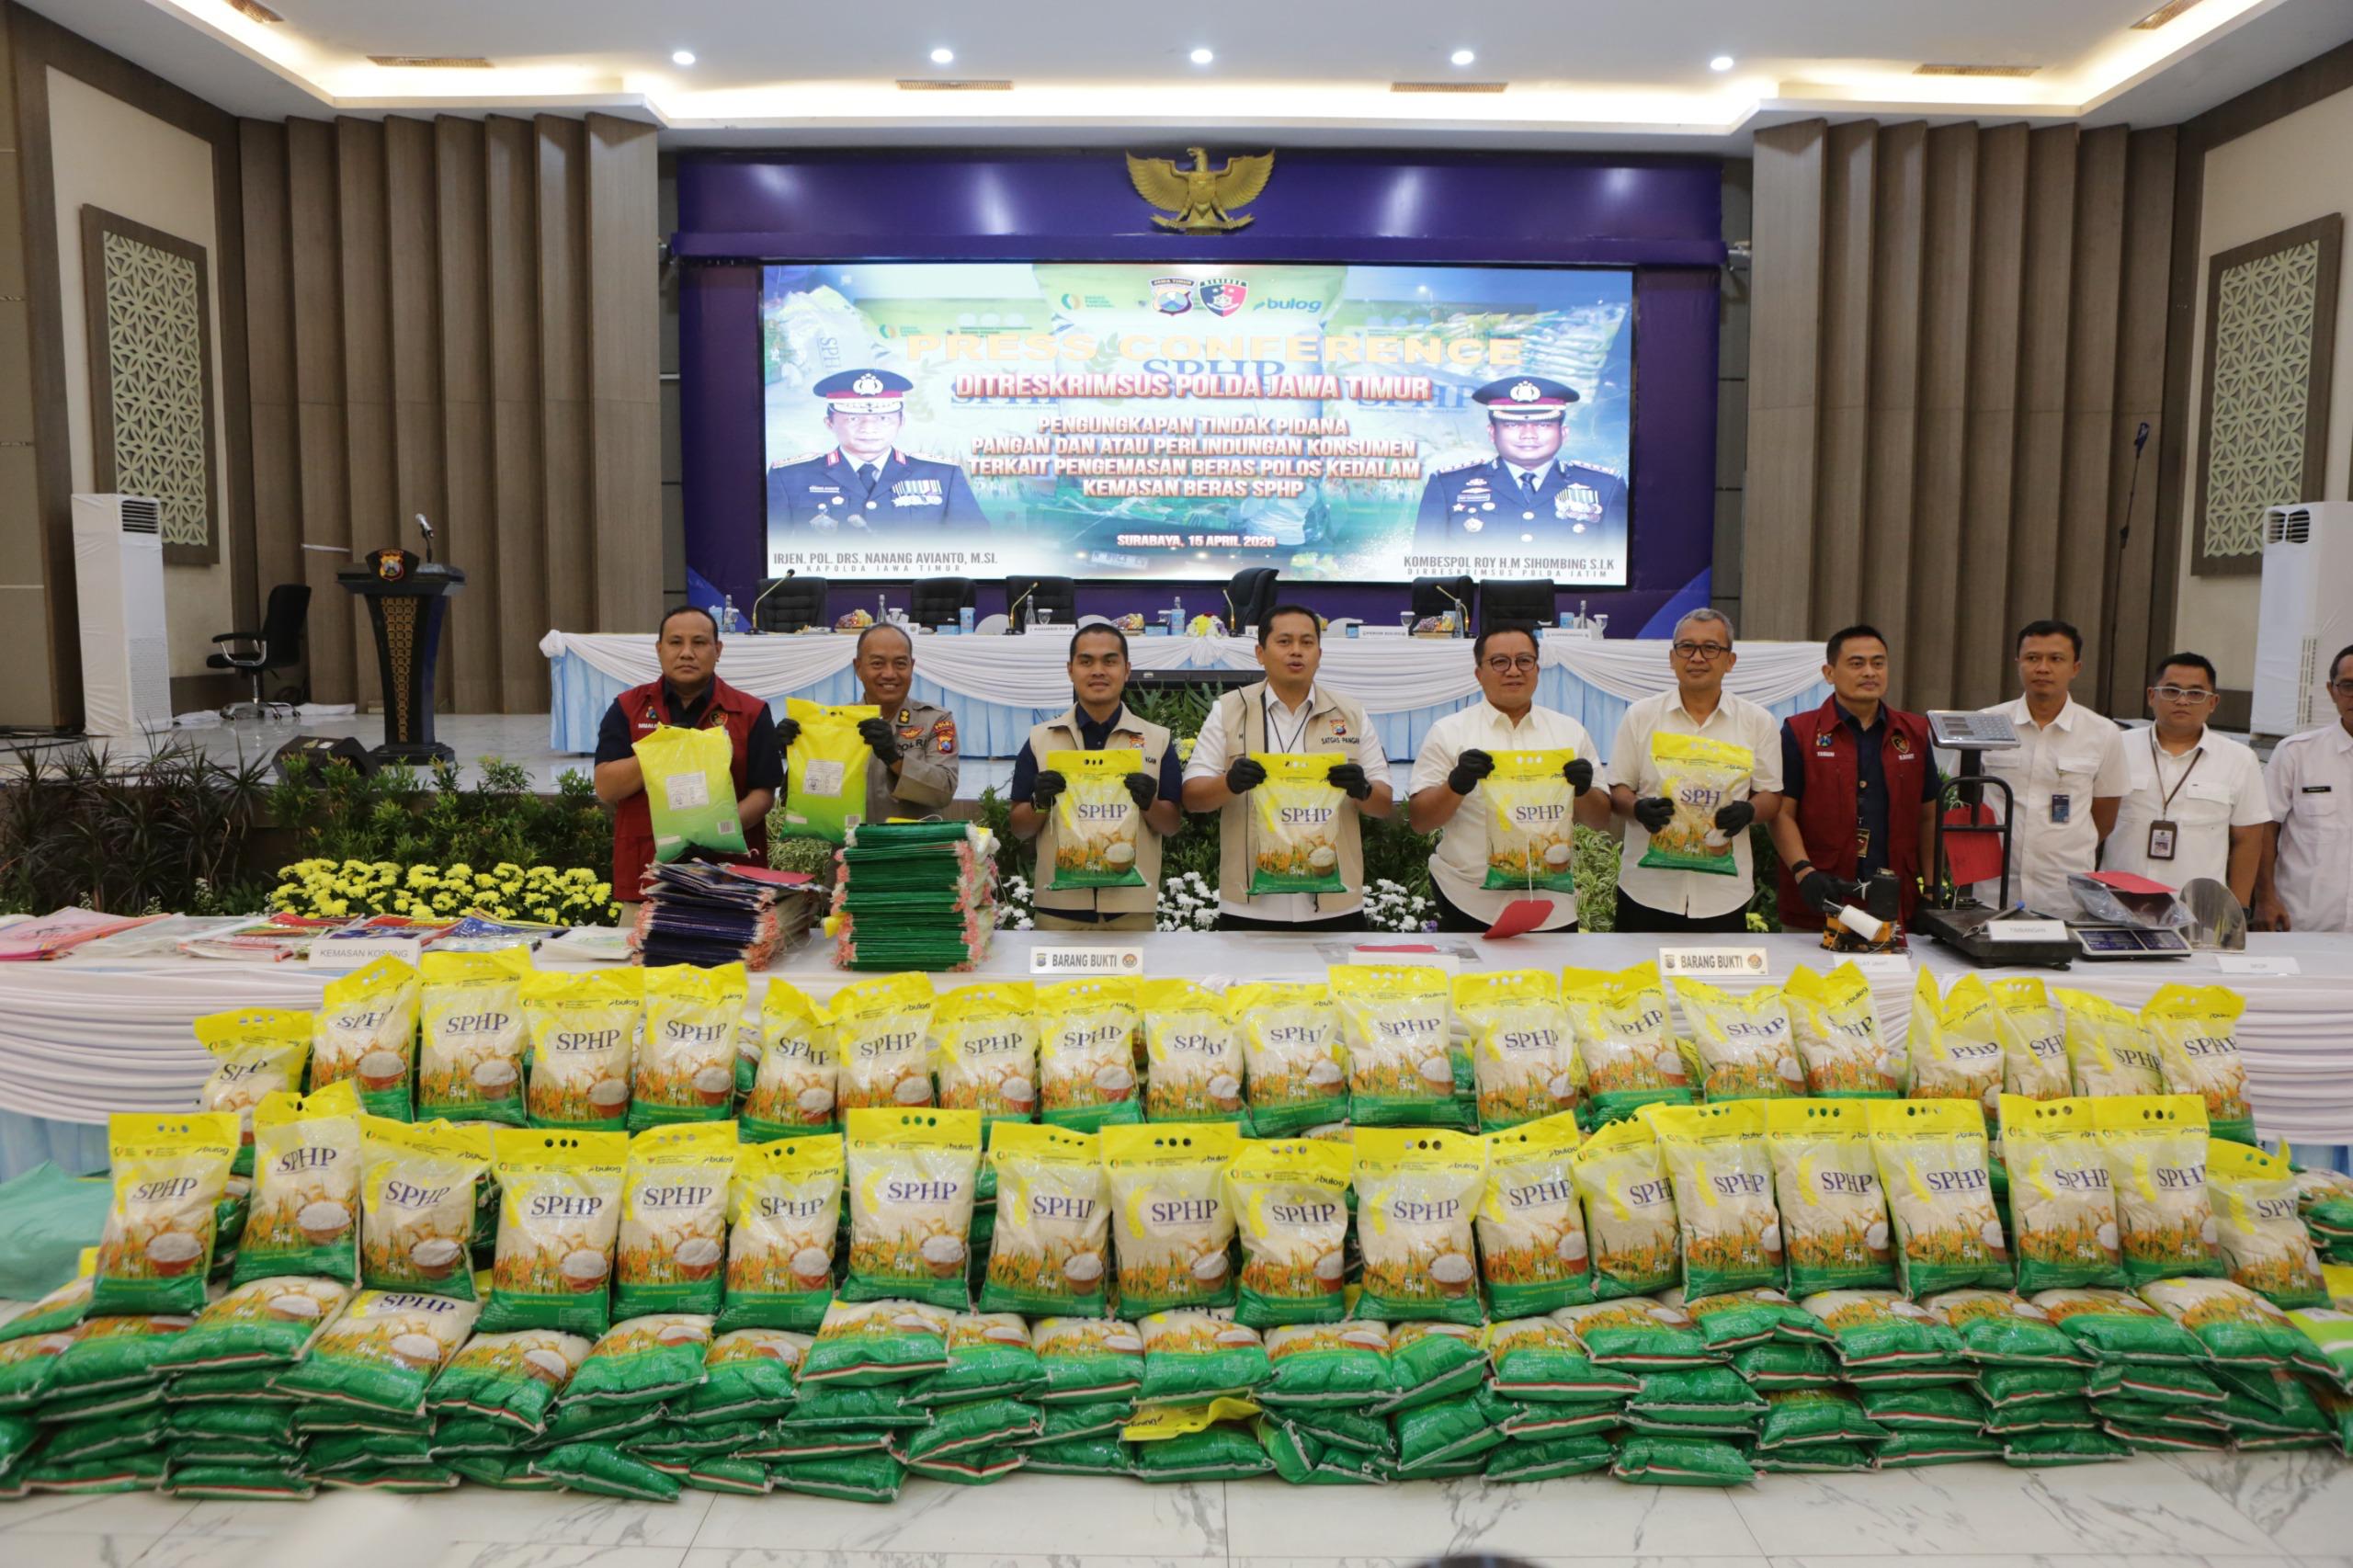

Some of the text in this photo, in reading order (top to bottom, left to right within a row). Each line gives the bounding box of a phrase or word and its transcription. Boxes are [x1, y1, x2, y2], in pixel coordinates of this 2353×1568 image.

[1267, 298, 1323, 312] bulog
[907, 334, 1097, 361] PRESS
[1118, 335, 1522, 366] CONFERENCE
[955, 373, 1170, 399] DITRESKRIMSUS
[1175, 374, 1259, 399] POLDA
[1267, 375, 1340, 400] JAWA
[1346, 376, 1432, 401] TIMUR
[1039, 416, 1349, 437] PENGUNGKAPAN TINDAK PIDANA
[972, 437, 1417, 458] PANGAN DAN ATAU PERLINDUNGAN KONSUMEN
[969, 458, 1422, 480] TERKAIT PENGEMASAN BERAS POLOS KEDALAM
[1083, 479, 1306, 499] KEMASAN BERAS SPHP
[1117, 534, 1185, 548] SURABAYA,
[1188, 535, 1205, 548] 15
[1206, 535, 1242, 548] APRIL
[773, 552, 806, 564] IRJEN.
[810, 553, 833, 564] POL.
[836, 553, 862, 564] DRS.
[865, 552, 913, 564] NANANG
[915, 553, 968, 565] AVIANTO,
[1404, 555, 1615, 570] KOMBESPOL ROY H.M SIHOMBING S.I.K
[1680, 789, 1722, 805] SPH
[1078, 804, 1128, 819] SPHP
[1281, 808, 1332, 823] SPHP
[1517, 805, 1564, 821] SPHP
[321, 949, 366, 958] KEMASAN
[1052, 954, 1118, 967] BARANG BUKTI
[1680, 955, 1743, 969] BARANG BUKTI
[615, 998, 640, 1007] bulog
[446, 1013, 509, 1034] SPHP
[665, 1019, 727, 1041] SPHP
[1380, 1018, 1440, 1037] SPHP
[1610, 1010, 1664, 1035] PHP
[1726, 1017, 1786, 1038] SPHP
[556, 1029, 620, 1051] SPHP
[860, 1032, 917, 1057] SPHP
[965, 1033, 1023, 1055] SPHP
[1064, 1026, 1122, 1048] SPHP
[1950, 1042, 1998, 1060] PHP
[277, 1148, 336, 1173] SPHP
[595, 1165, 622, 1174] bulog
[710, 1155, 733, 1165] bulog
[1454, 1163, 1479, 1171] bulog
[1319, 1175, 1345, 1187] bulog
[1714, 1174, 1765, 1194] SPHP
[1821, 1172, 1872, 1193] SPHP
[1927, 1168, 1986, 1191] SPHP
[2054, 1168, 2109, 1189] SPHP
[2156, 1165, 2205, 1187] SPH
[133, 1176, 199, 1200] SPHP
[385, 1180, 450, 1207] SPHP
[643, 1186, 712, 1207] SPHP
[887, 1181, 958, 1200] SPHP
[1509, 1178, 1574, 1208] SPHP
[531, 1196, 603, 1216] SPHP
[761, 1196, 824, 1218] SPHP
[1152, 1199, 1219, 1222] SPHP
[1272, 1203, 1336, 1223] SPHP
[1392, 1199, 1460, 1221] SPHP
[272, 1230, 280, 1241] 5
[1845, 1250, 1852, 1260] 5
[1963, 1246, 1971, 1256] 5
[2078, 1245, 2086, 1257] 5
[2182, 1245, 2189, 1256] 5
[651, 1265, 658, 1276] 5
[895, 1258, 903, 1268] 5
[766, 1274, 773, 1285] 5
[1038, 1275, 1045, 1286] 5
[1405, 1278, 1413, 1290] 5
[380, 1294, 456, 1313] SPHP
